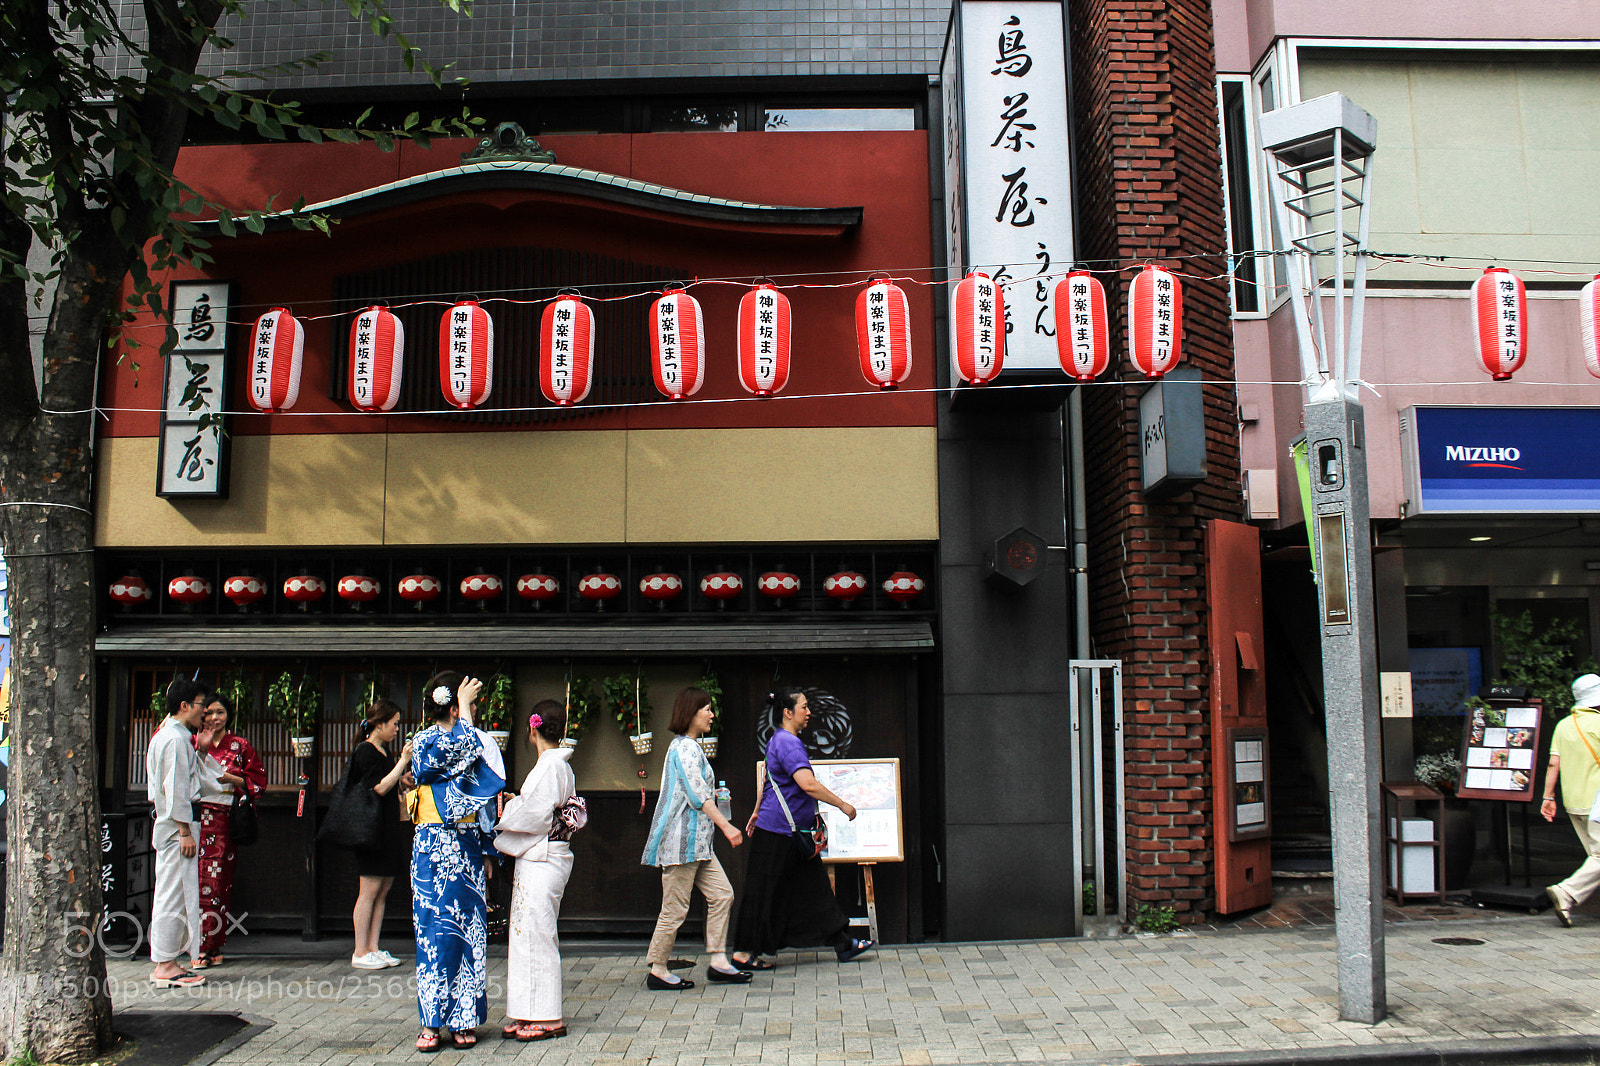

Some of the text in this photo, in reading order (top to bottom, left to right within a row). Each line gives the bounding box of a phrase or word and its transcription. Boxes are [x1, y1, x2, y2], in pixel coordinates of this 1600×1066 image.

[991, 15, 1047, 227] 鳥茶屋
[978, 283, 993, 369] 神楽坂まつり
[1035, 242, 1056, 337] うどん
[1072, 283, 1089, 366] 神楽坂まつり
[1156, 278, 1171, 362] 神楽坂まつり
[1500, 280, 1517, 361] 神楽坂まつり
[255, 317, 274, 399] 神楽坂まつり
[357, 317, 371, 399] 神楽坂まつり
[453, 311, 468, 393] 神楽坂まつり
[555, 308, 571, 391] 神楽坂まつり
[660, 302, 677, 384] 神楽坂まつり
[759, 294, 774, 379] 神楽坂まつり
[869, 291, 887, 372] 神楽坂まつり
[1446, 445, 1521, 462] MIZUHO
